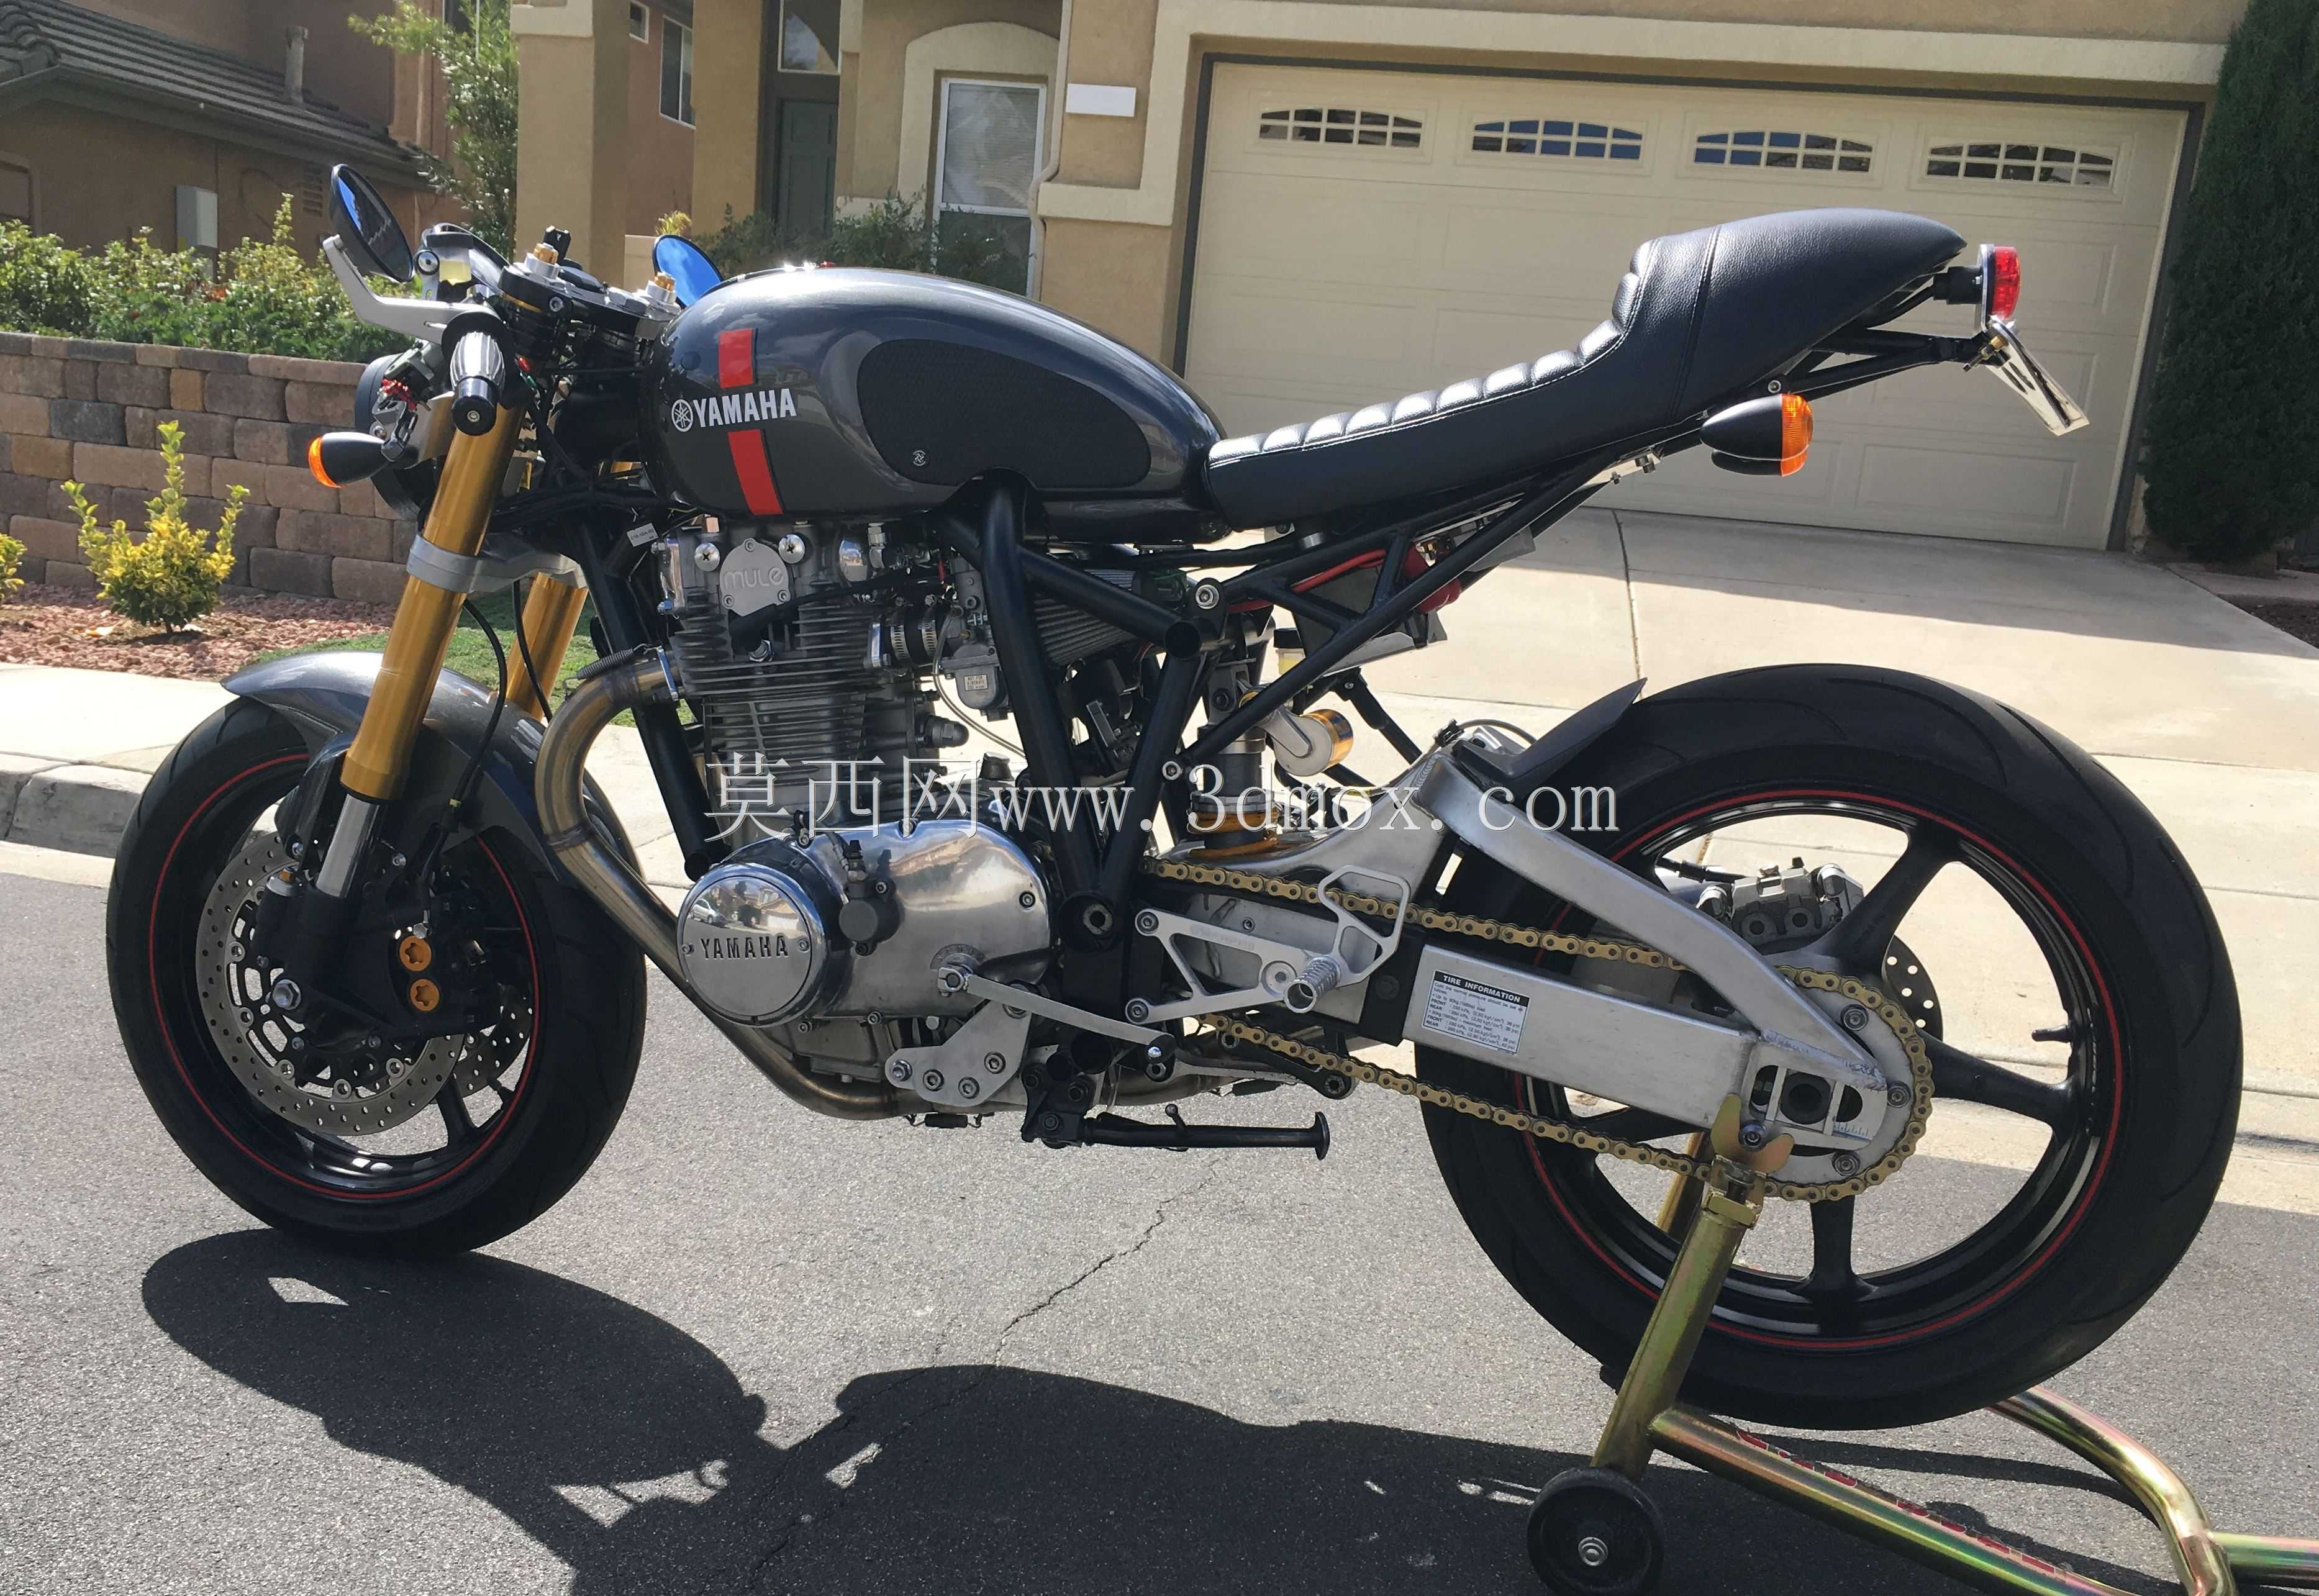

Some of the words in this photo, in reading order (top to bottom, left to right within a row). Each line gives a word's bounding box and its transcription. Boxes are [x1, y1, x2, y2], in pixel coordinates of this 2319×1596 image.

[693, 388, 797, 428] YAMAHA
[700, 935, 789, 961] YAMAHA
[1443, 975, 1461, 986] TIRE
[1464, 982, 1520, 1003] INFORMATION
